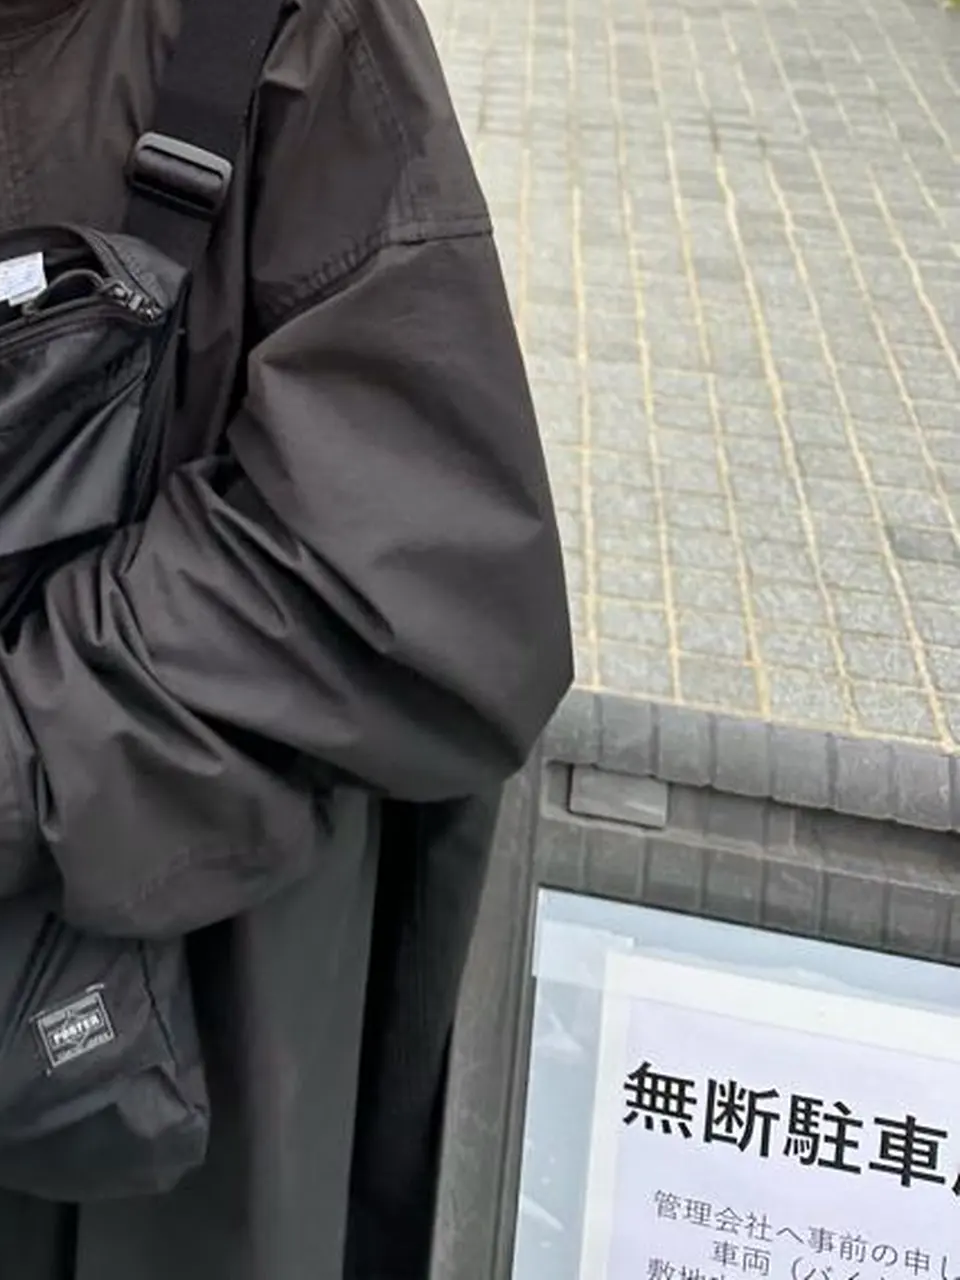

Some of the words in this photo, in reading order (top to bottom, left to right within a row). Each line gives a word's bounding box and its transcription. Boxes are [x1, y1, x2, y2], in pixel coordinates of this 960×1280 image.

[53, 1014, 100, 1045] PORTER
[623, 1061, 960, 1195] 無断駐車
